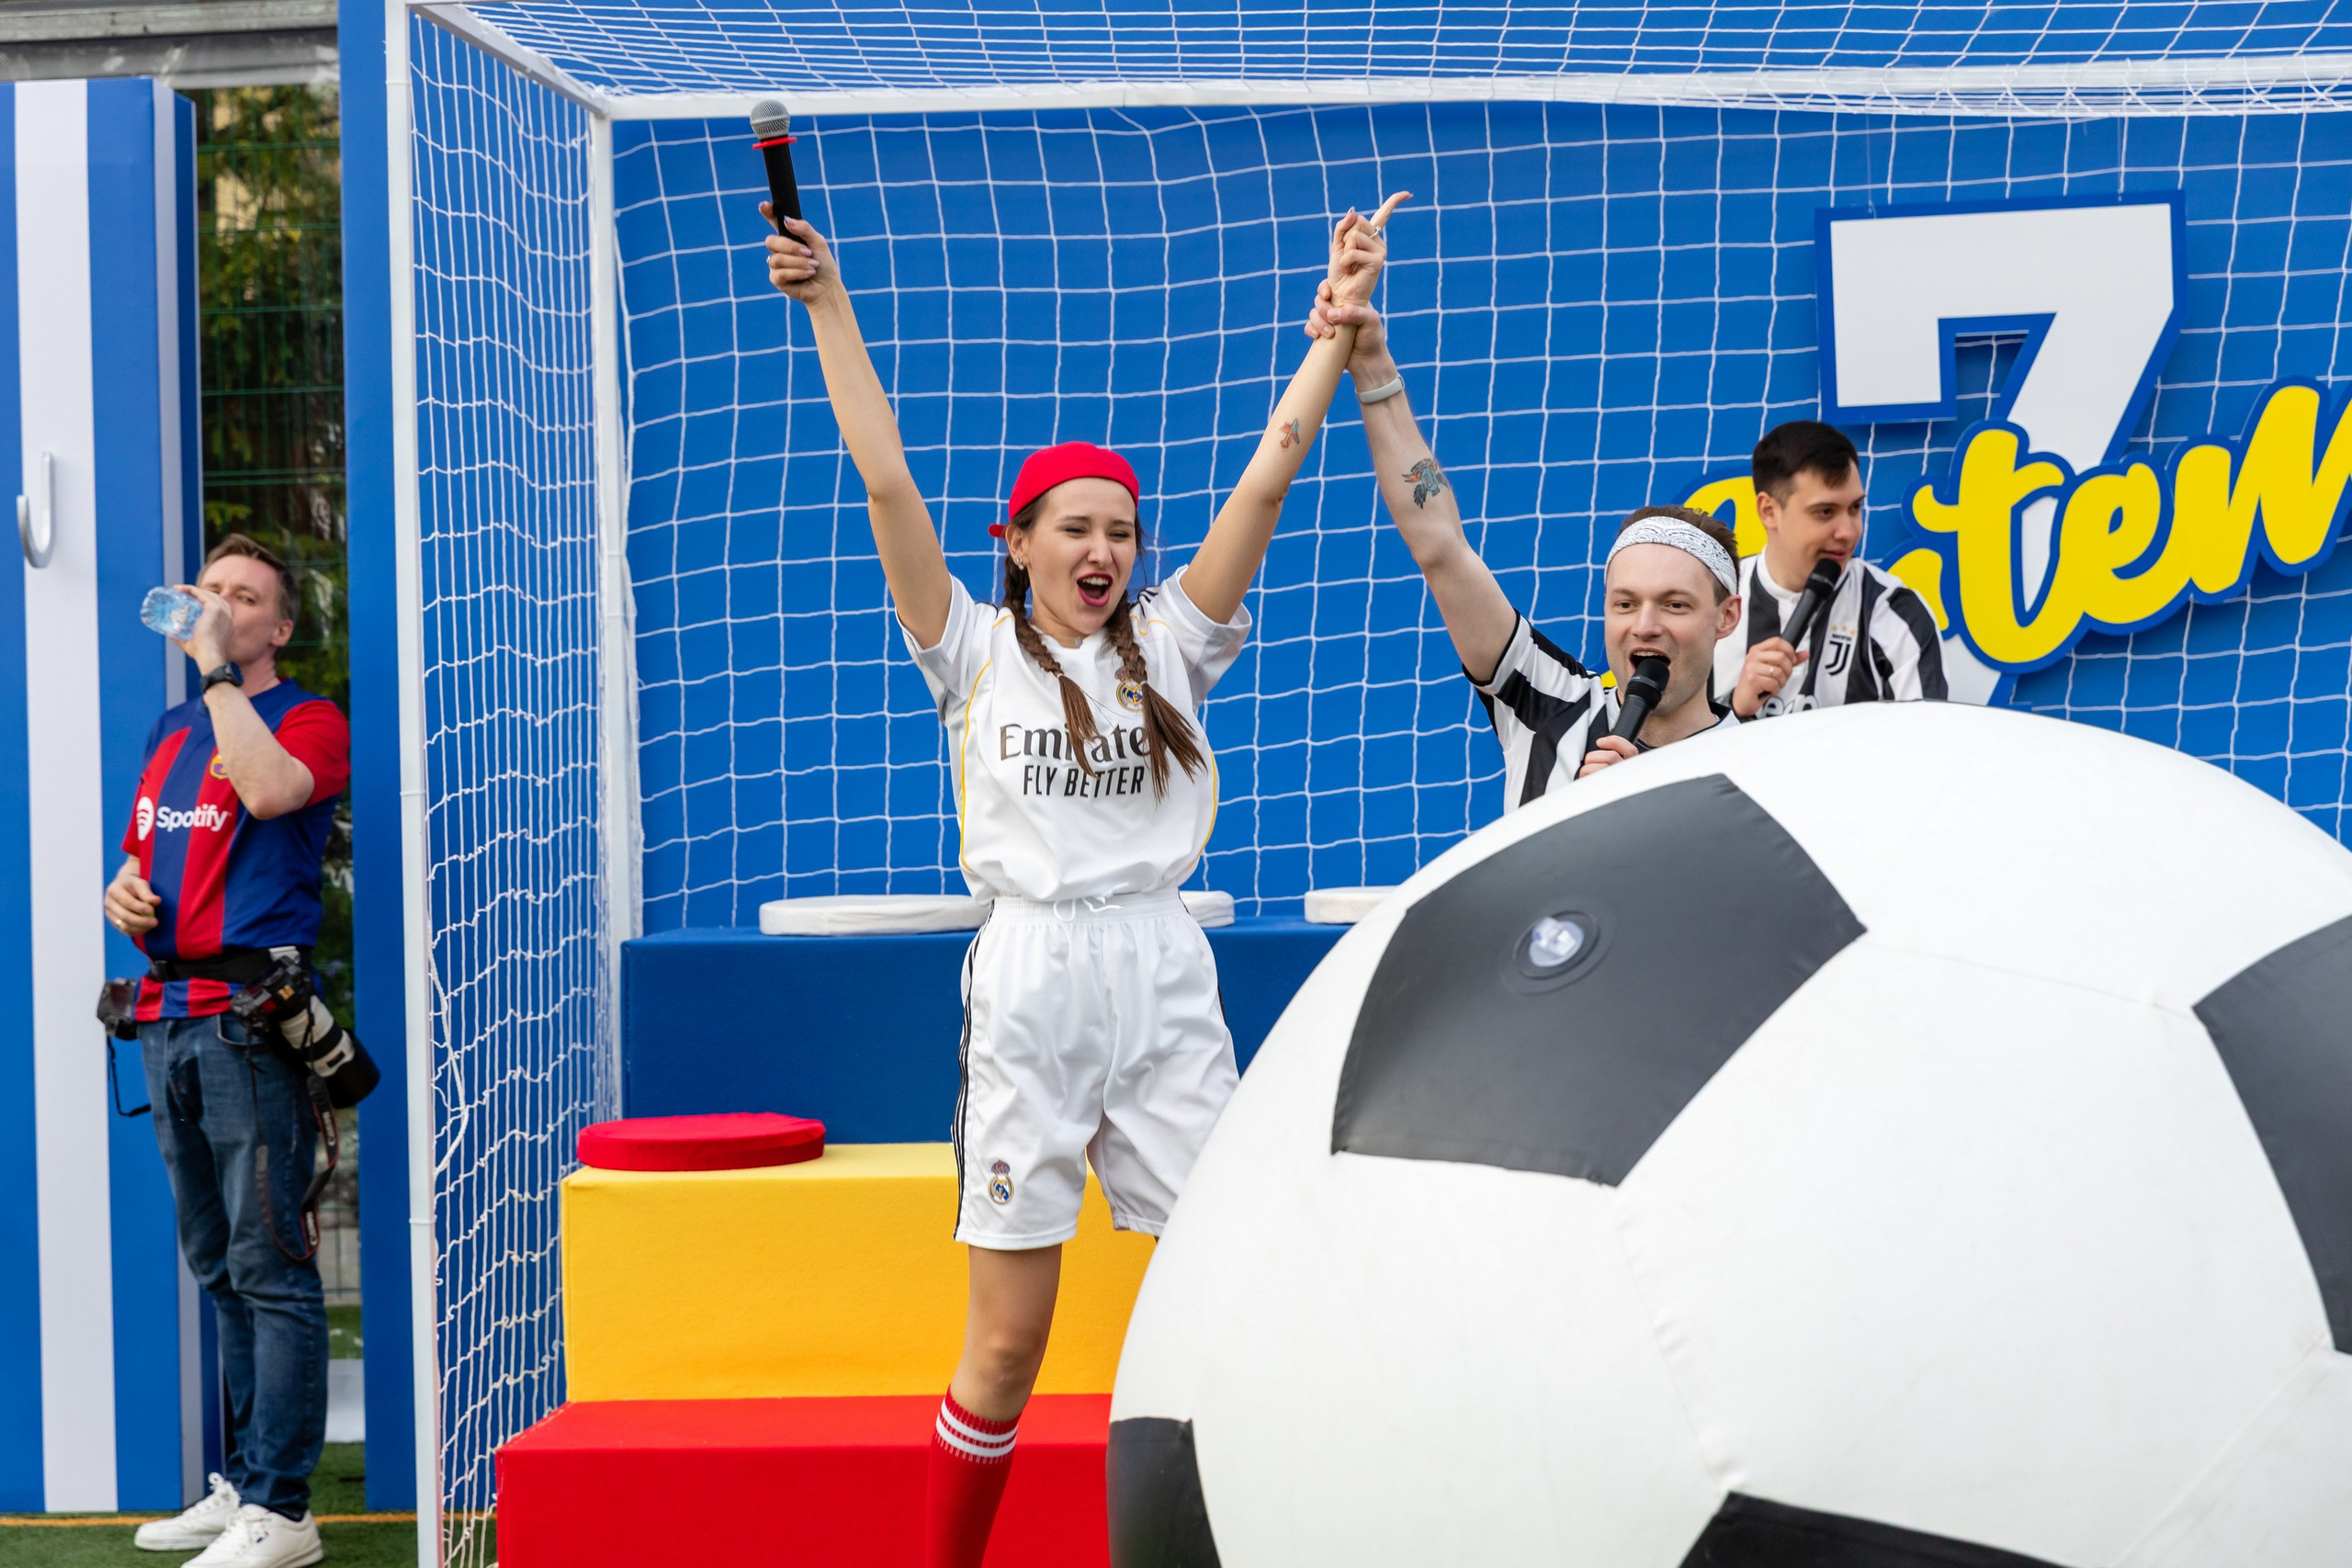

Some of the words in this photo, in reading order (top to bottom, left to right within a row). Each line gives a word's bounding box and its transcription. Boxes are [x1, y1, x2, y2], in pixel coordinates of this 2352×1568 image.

[1831, 203, 2174, 705] 7
[1000, 724, 1149, 762] Emiate
[1023, 765, 1057, 796] FLY
[1064, 766, 1146, 798] BETTER
[156, 803, 229, 832] Spotify
